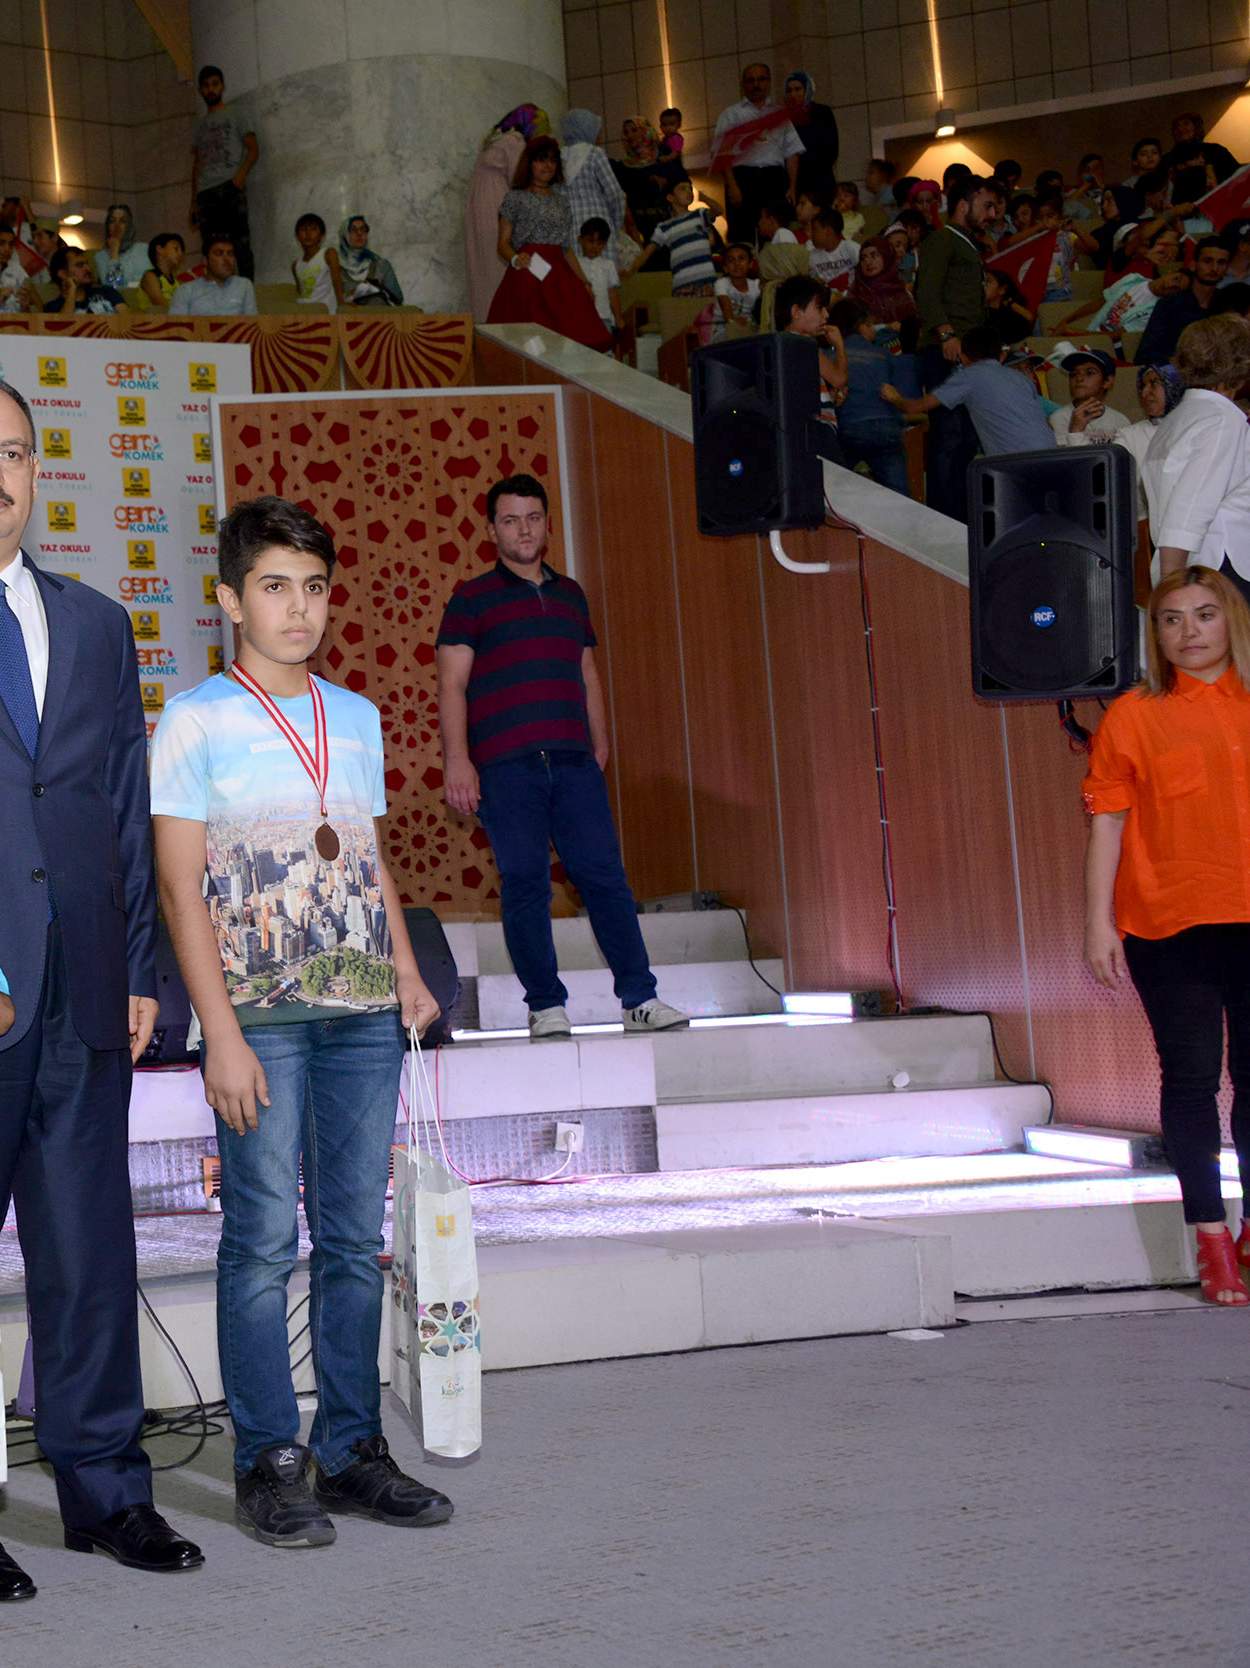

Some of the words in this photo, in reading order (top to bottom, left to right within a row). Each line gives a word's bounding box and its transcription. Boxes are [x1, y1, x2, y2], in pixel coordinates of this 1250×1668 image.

[30, 398, 47, 406] YAZ
[49, 398, 81, 407] OKULU
[39, 543, 57, 552] YAZ
[59, 544, 90, 552] OKULU
[1034, 611, 1054, 622] RCF
